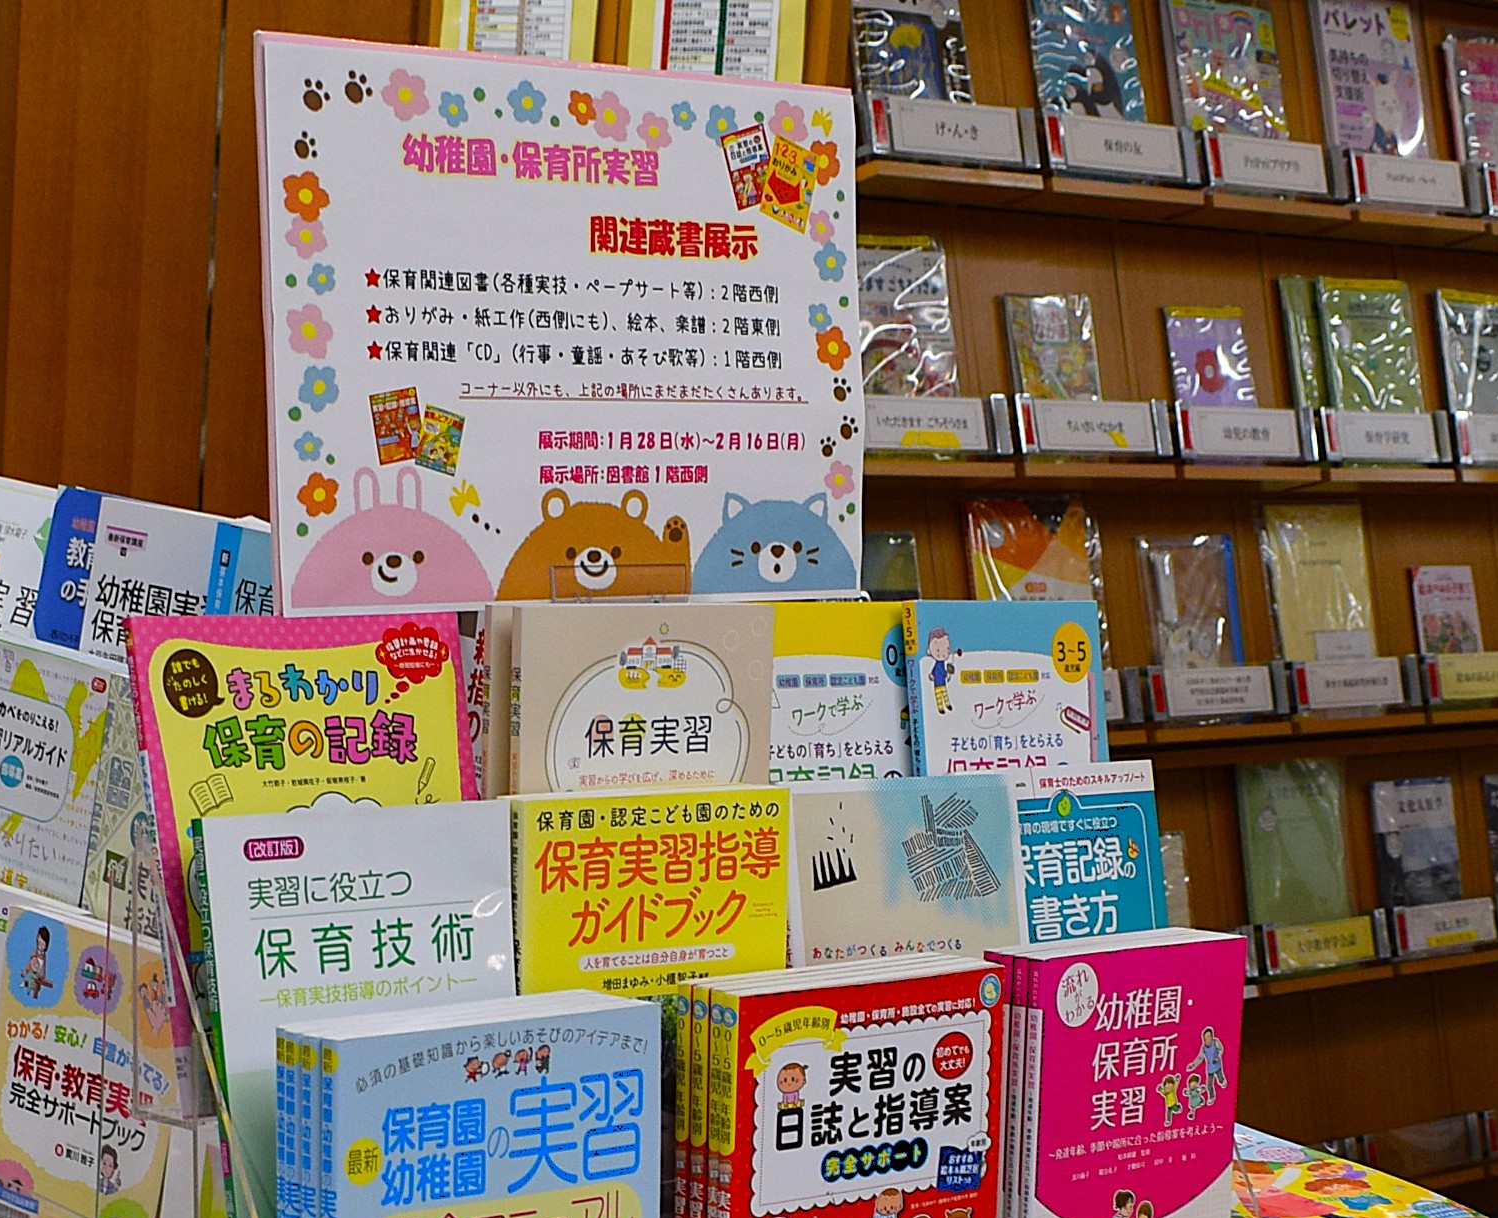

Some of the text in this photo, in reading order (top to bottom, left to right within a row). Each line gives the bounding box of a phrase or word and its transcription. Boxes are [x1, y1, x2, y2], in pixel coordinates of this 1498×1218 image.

[401, 132, 661, 187] 幼稚園・保育所実習
[589, 215, 759, 260] 関連蔵書展示
[460, 382, 803, 401] コーナー以外にも、上記の場所にまだまだたくさんあります。
[172, 675, 207, 692] たのしく
[225, 664, 379, 710] まるわかり
[973, 691, 1038, 721] ワークで学ぶ
[790, 694, 865, 724] ワークで学ぶ
[203, 710, 418, 770] 保育の記録
[584, 715, 713, 759] 保育実習
[950, 733, 1064, 751] 子どもの「育ち」をとらえる
[1039, 771, 1145, 790] 保育士のためのスキルアップノート
[537, 802, 779, 832] 保育園・認定こども園のための
[534, 837, 780, 894] 保育実習指導
[248, 870, 412, 910] 実習に役立つ
[568, 891, 747, 946] ガイドブック
[1029, 894, 1118, 939] 書き方
[255, 913, 475, 980] 保育技術
[584, 947, 730, 971] 人を育てることは自分自身が育つこと
[811, 938, 962, 960] あなたがつくる みんなでつくる
[1061, 969, 1090, 999] 流れ
[1065, 996, 1095, 1022] わかる
[6, 1020, 88, 1050] わかる! 安心!
[355, 1027, 648, 1093] 必須の基礎知識から楽しいあそびのアイデアまで!
[829, 1046, 926, 1097] 実習の
[1092, 1033, 1178, 1083] 保育所
[9, 1086, 144, 1152] 完全サポートブック
[382, 1097, 486, 1153] 保育園
[487, 1068, 643, 1193] の 実習
[776, 1083, 972, 1151] 日誌と指導案
[1091, 1086, 1146, 1131] 実習
[346, 1145, 381, 1176] 最新
[381, 1150, 486, 1207] 幼稚園
[825, 1143, 922, 1177] 完全サポート
